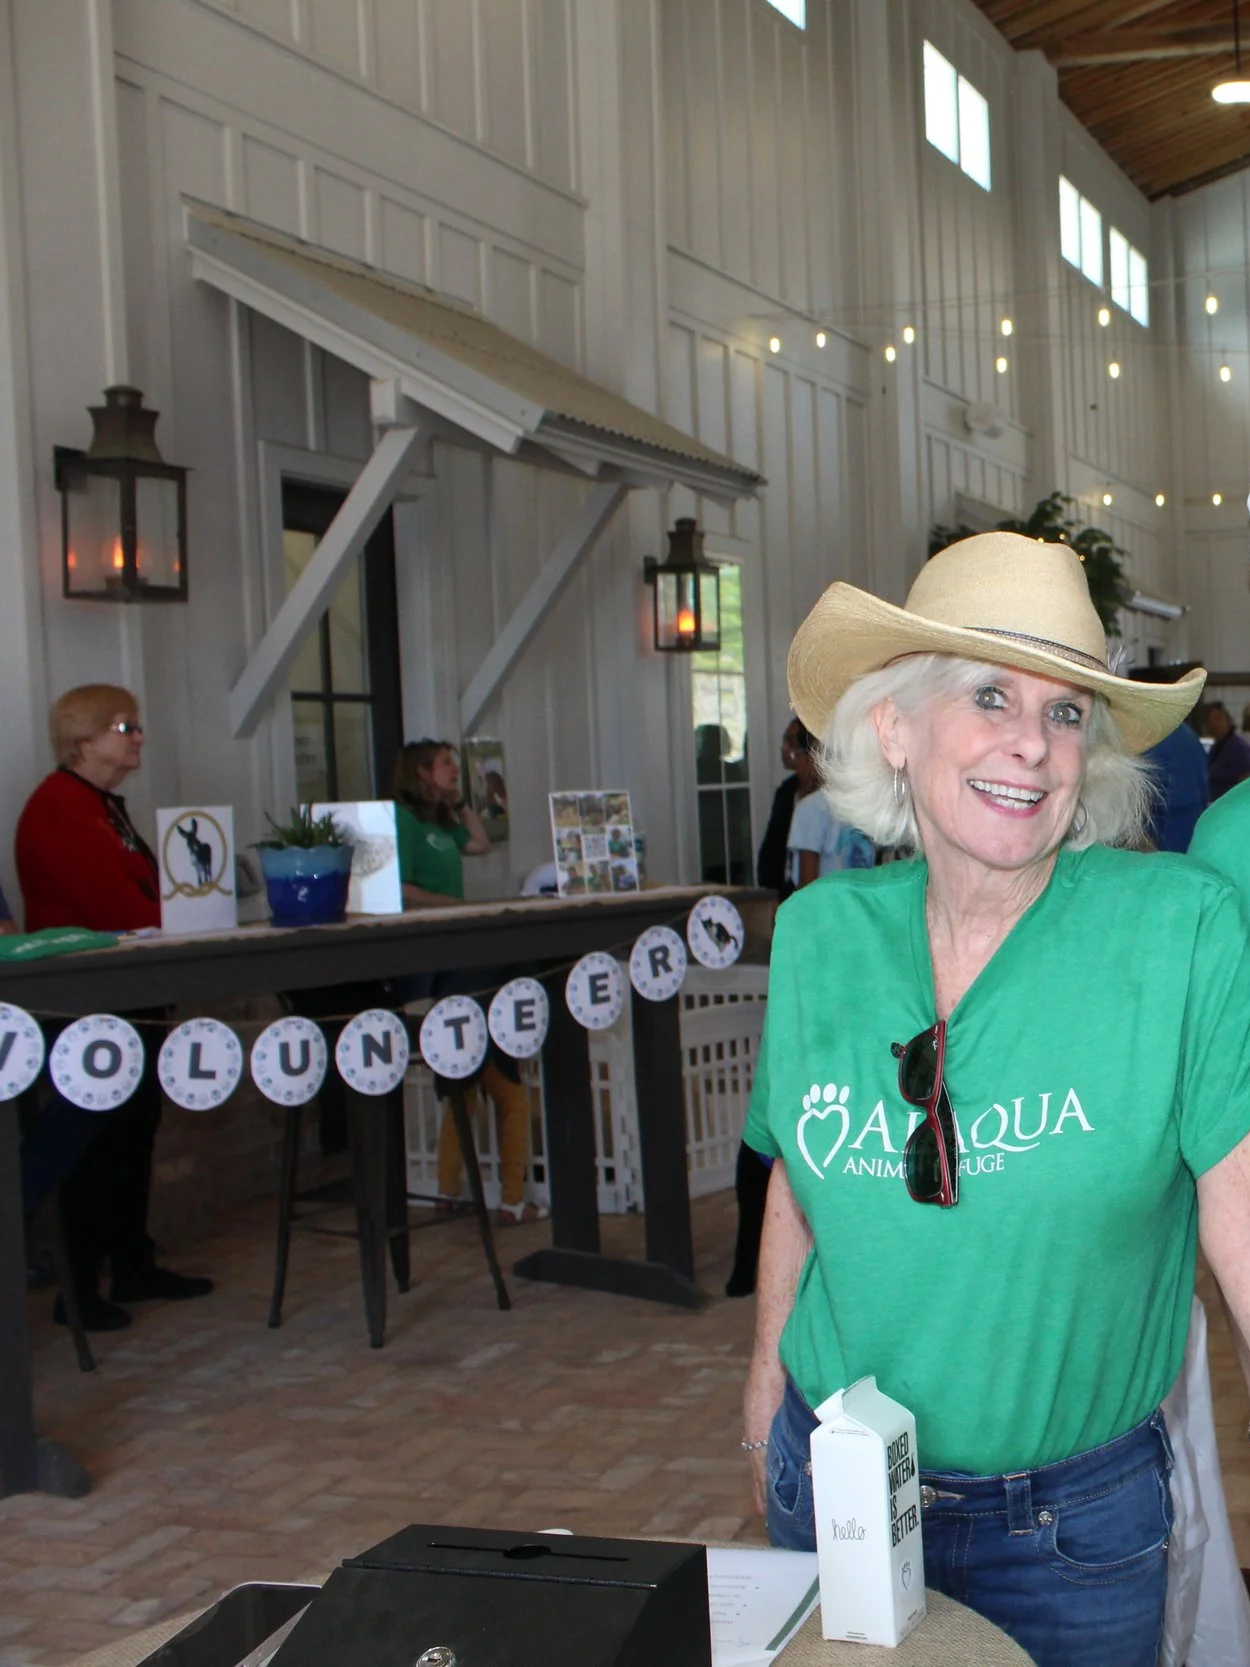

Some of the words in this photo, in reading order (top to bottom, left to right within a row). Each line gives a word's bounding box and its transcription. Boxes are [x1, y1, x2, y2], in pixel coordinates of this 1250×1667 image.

[842, 1156, 905, 1179] ANIM
[958, 1152, 1005, 1177] FUGE
[887, 1431, 909, 1470] BOXED
[888, 1456, 911, 1495] WATER
[890, 1495, 898, 1521] IS
[831, 1517, 867, 1541] hello
[891, 1504, 919, 1547] BETTER.
